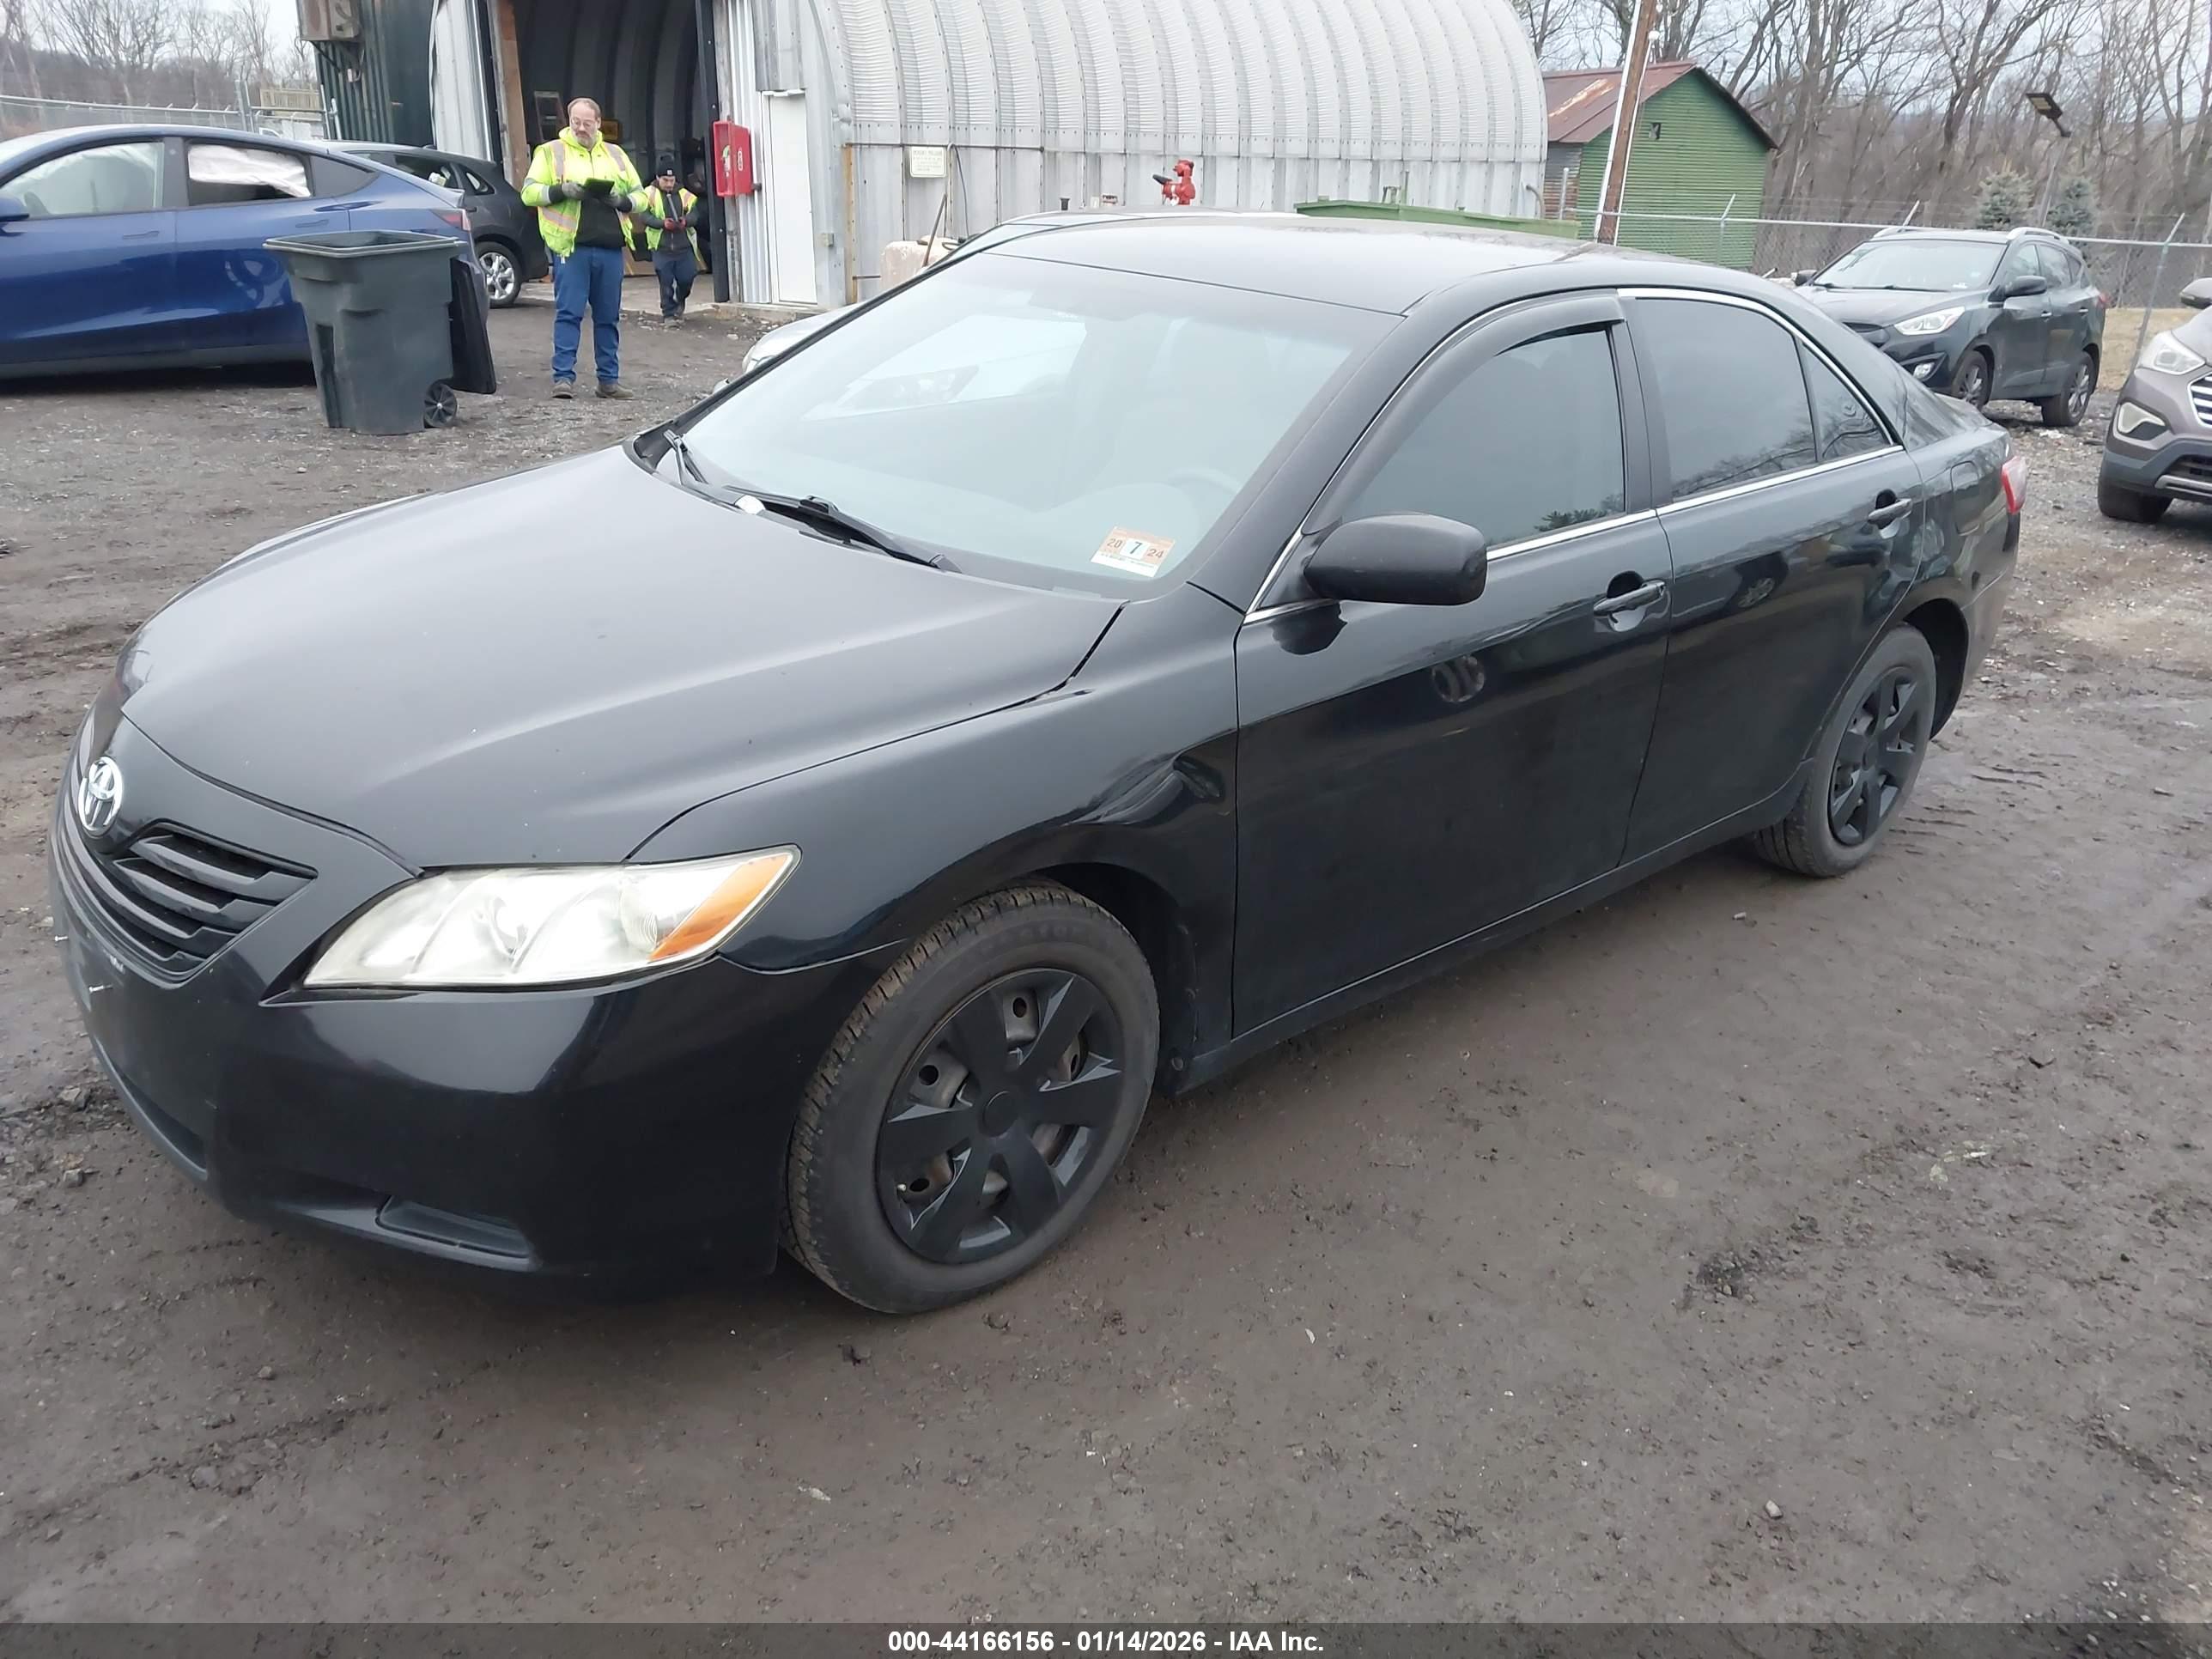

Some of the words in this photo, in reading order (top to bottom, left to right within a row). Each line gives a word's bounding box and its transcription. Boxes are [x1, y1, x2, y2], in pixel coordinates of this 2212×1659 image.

[1106, 538, 1123, 549] 20
[1129, 541, 1143, 555] 7
[1147, 548, 1164, 559] 24
